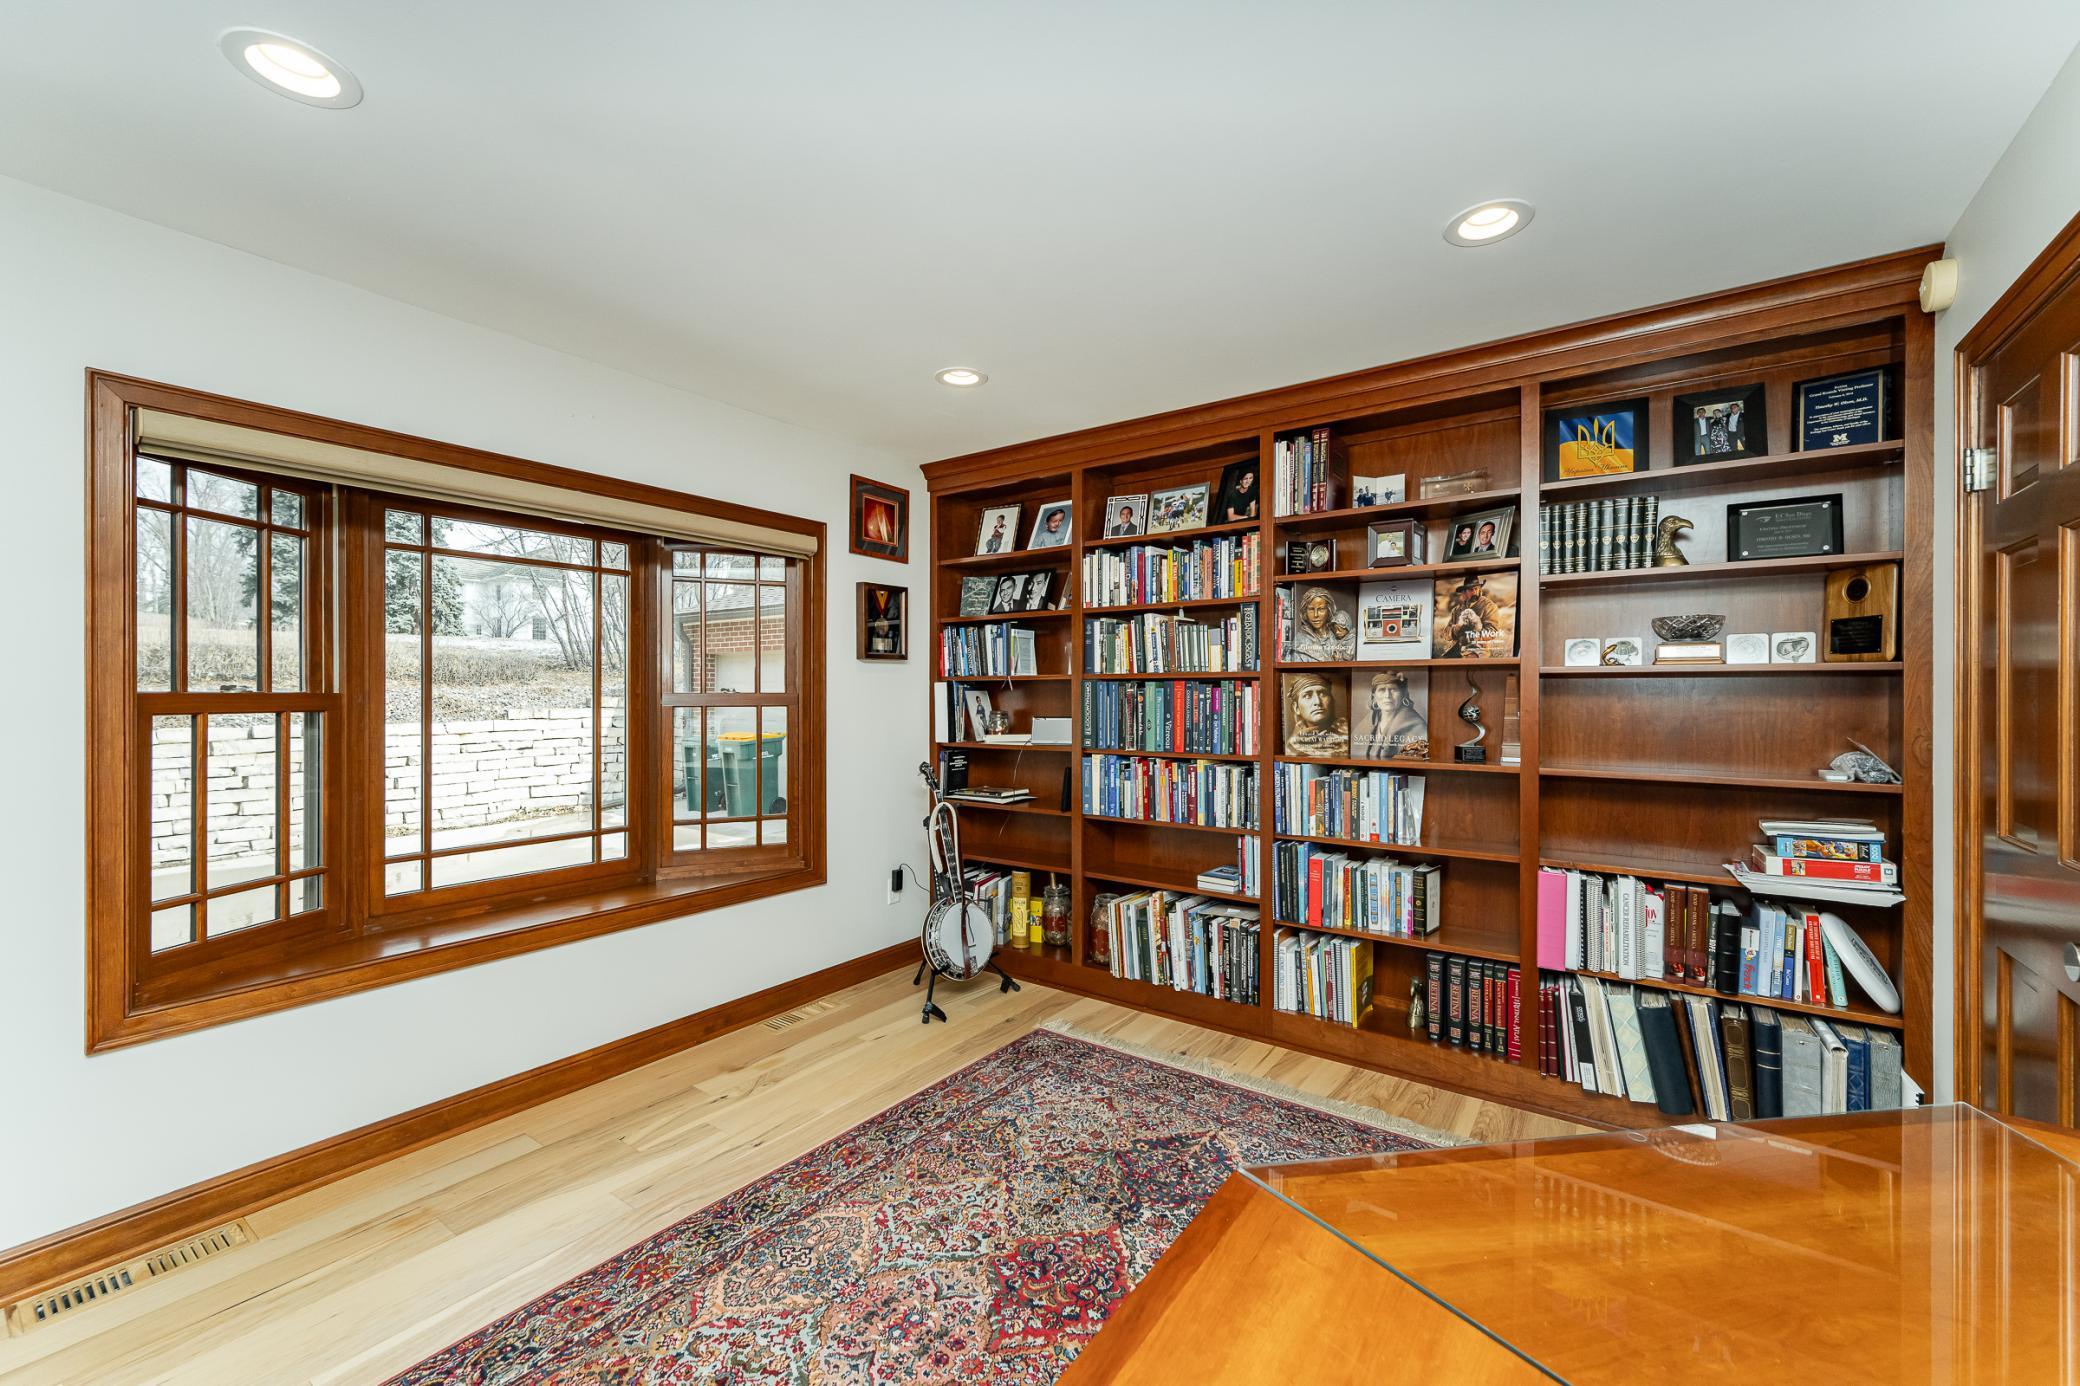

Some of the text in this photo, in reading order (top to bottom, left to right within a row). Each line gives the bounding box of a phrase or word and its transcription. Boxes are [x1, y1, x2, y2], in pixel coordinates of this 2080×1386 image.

[1376, 594, 1412, 603] CAMERA
[1465, 629, 1505, 639] The Work
[1353, 734, 1424, 743] SACRED LEGACY
[1622, 893, 1630, 966] CANCER REHABILITATION
[1709, 940, 1717, 953] HOPE
[1430, 981, 1439, 1012] RETINA
[1451, 985, 1460, 1017] RETINA
[1470, 989, 1479, 1021] RETINA
[1512, 1025, 1520, 1042] ATLAS
